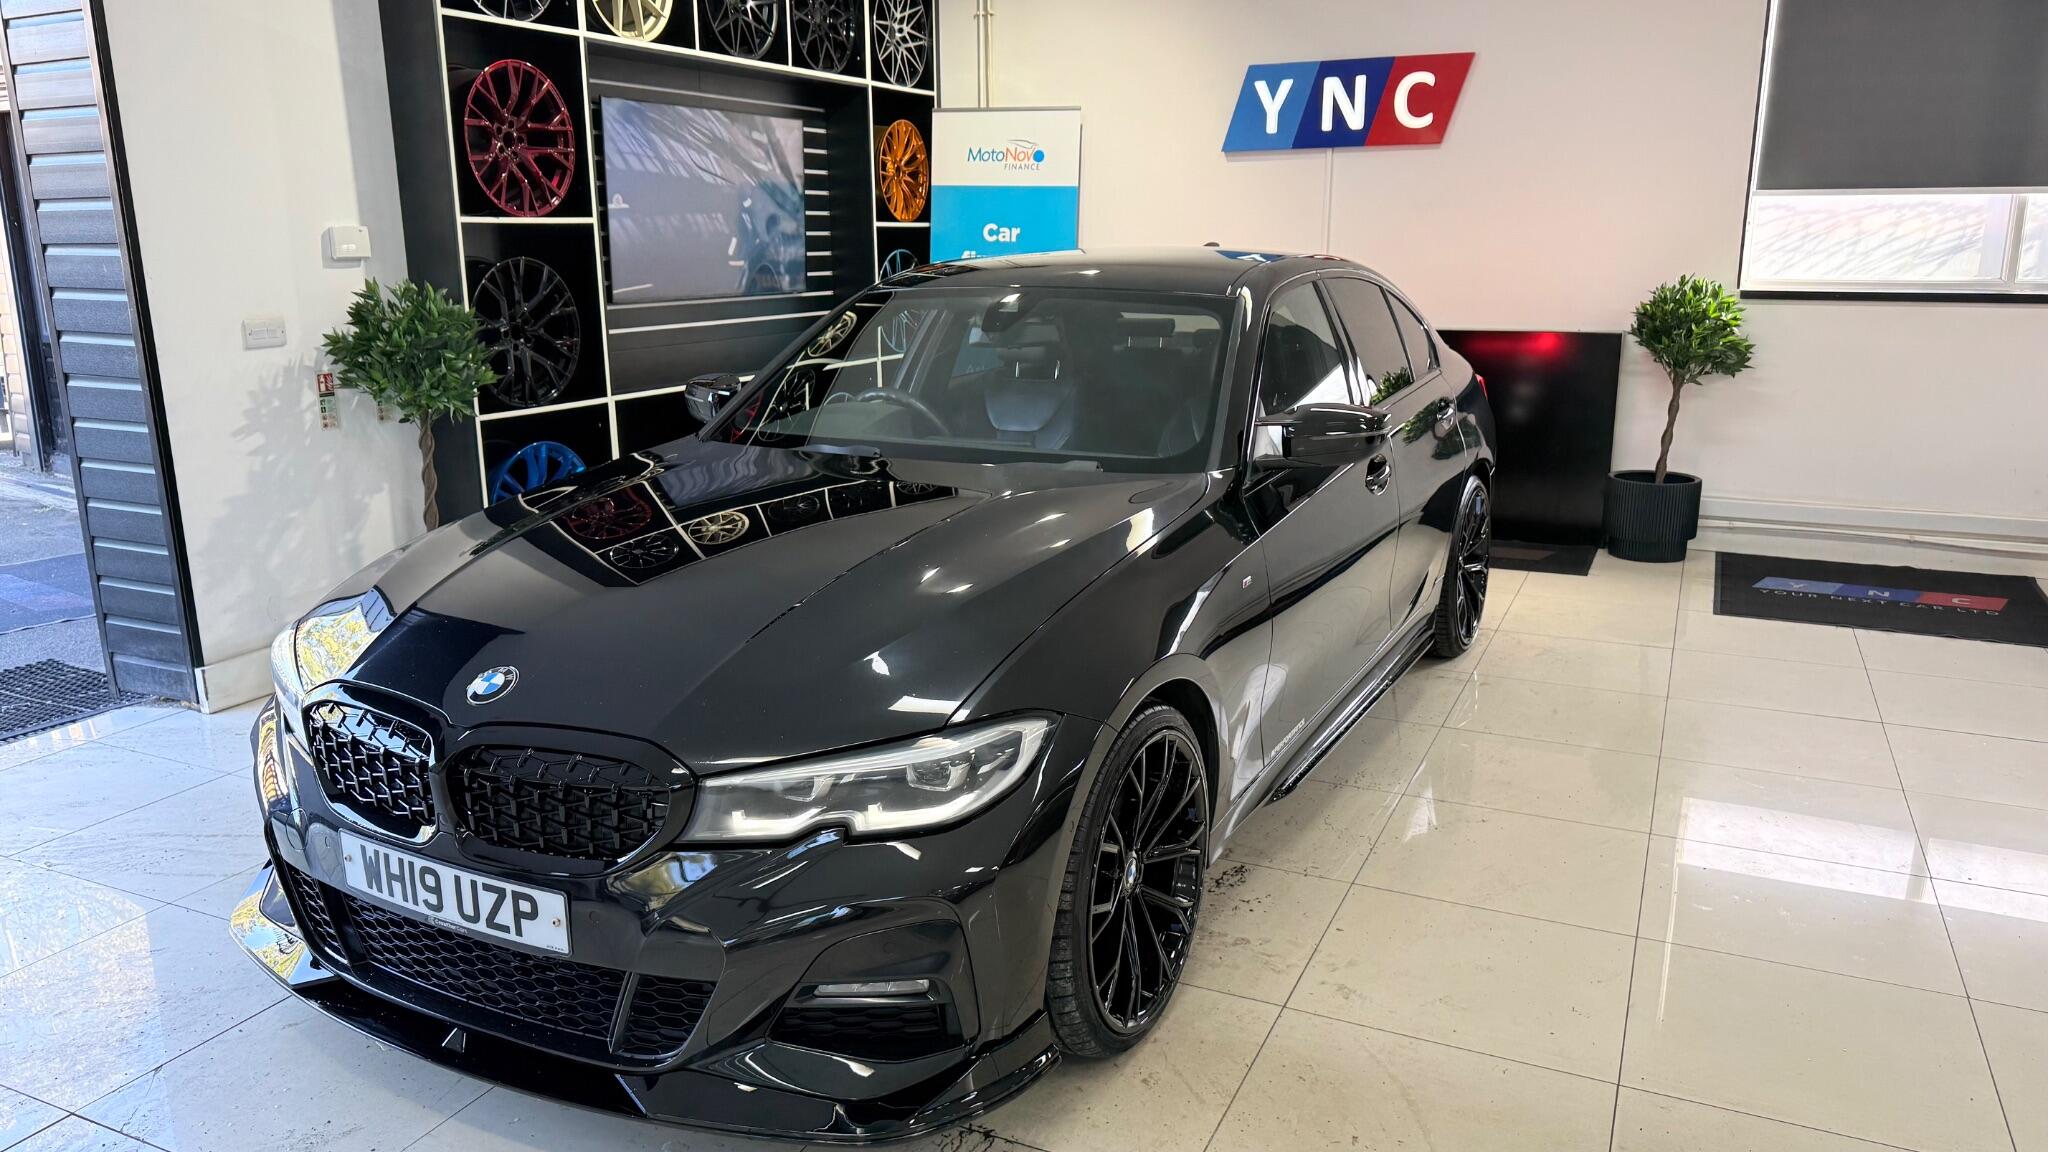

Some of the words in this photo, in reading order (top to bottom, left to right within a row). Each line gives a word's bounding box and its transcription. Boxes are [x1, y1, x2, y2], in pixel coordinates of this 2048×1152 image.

[1004, 163, 1041, 171] FINANCE
[982, 223, 1021, 242] Car
[1759, 588, 1818, 599] YOUR
[1830, 595, 1890, 606] NEXT
[1899, 602, 1945, 611] CAR
[1956, 607, 2000, 616] LTD
[359, 843, 444, 914] WH19
[453, 873, 540, 938] UZP
